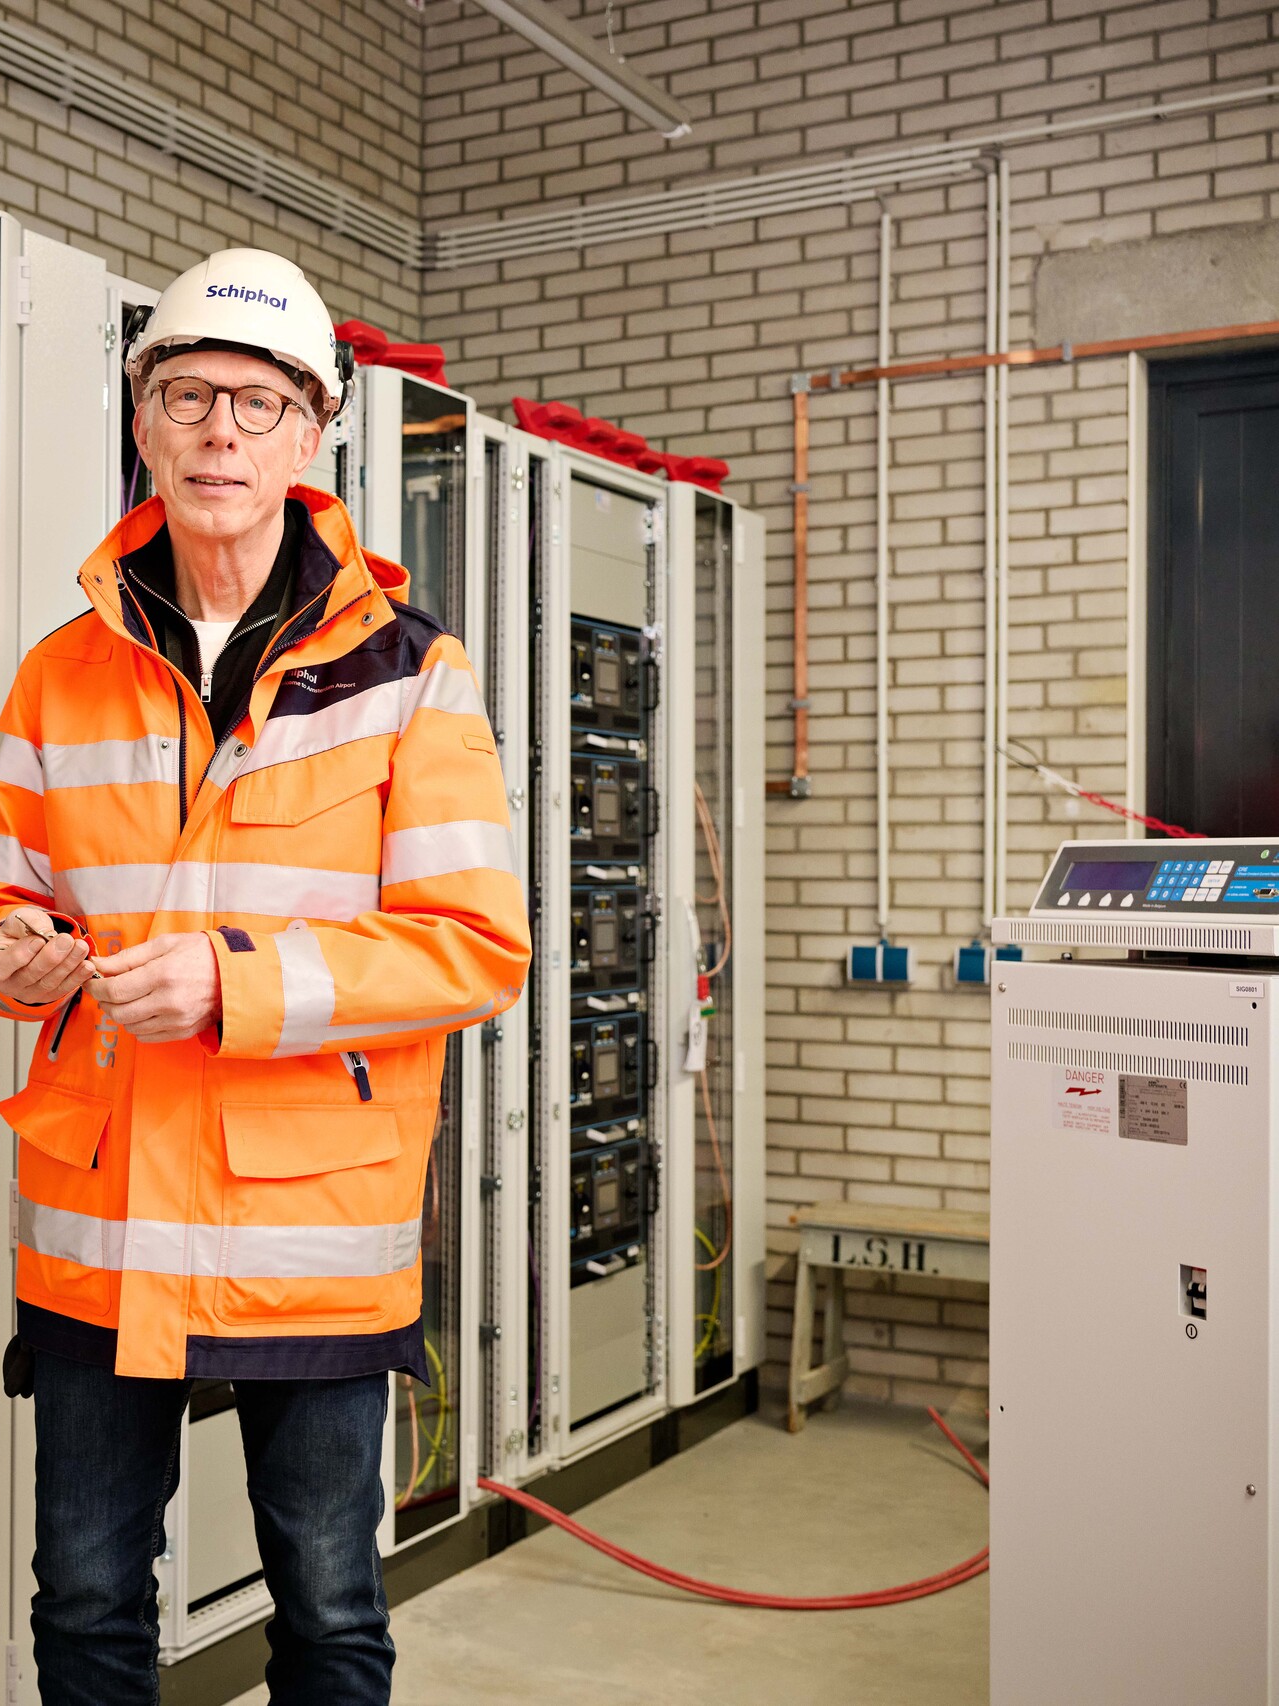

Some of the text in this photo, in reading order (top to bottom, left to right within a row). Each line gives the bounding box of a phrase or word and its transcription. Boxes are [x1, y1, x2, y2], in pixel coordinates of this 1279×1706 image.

[206, 284, 287, 311] Schiphol
[1236, 985, 1258, 994] SIG0801
[1065, 1069, 1105, 1084] DANGER
[832, 1234, 939, 1274] L.S.H.
